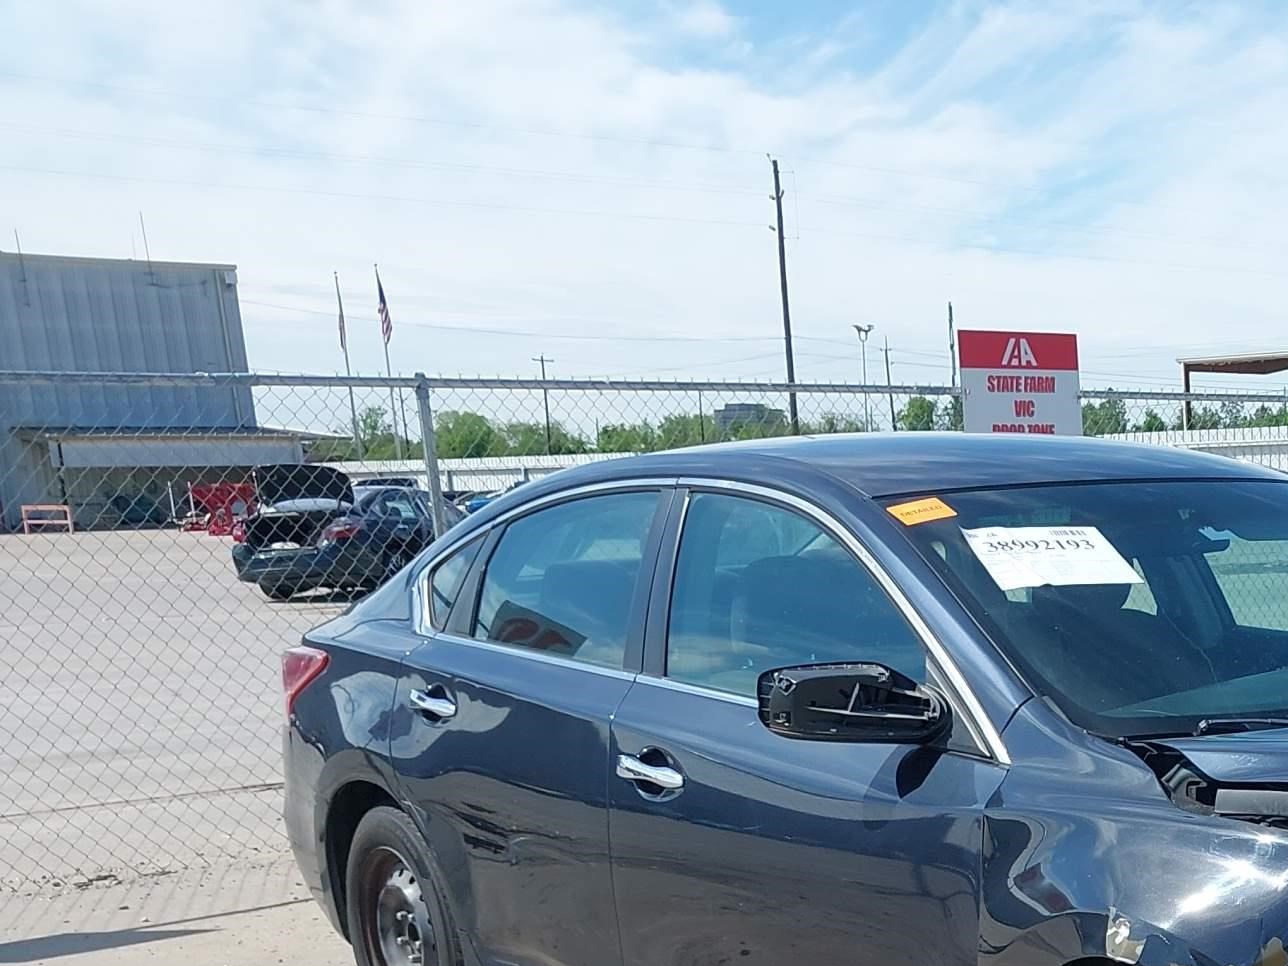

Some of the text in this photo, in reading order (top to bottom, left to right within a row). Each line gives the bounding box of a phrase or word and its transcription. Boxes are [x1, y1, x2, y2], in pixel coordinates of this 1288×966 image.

[987, 375, 1056, 393] STATE FARM
[1014, 400, 1035, 418] VIC
[900, 504, 943, 517] DETAILED
[982, 539, 1095, 553] 38992193
